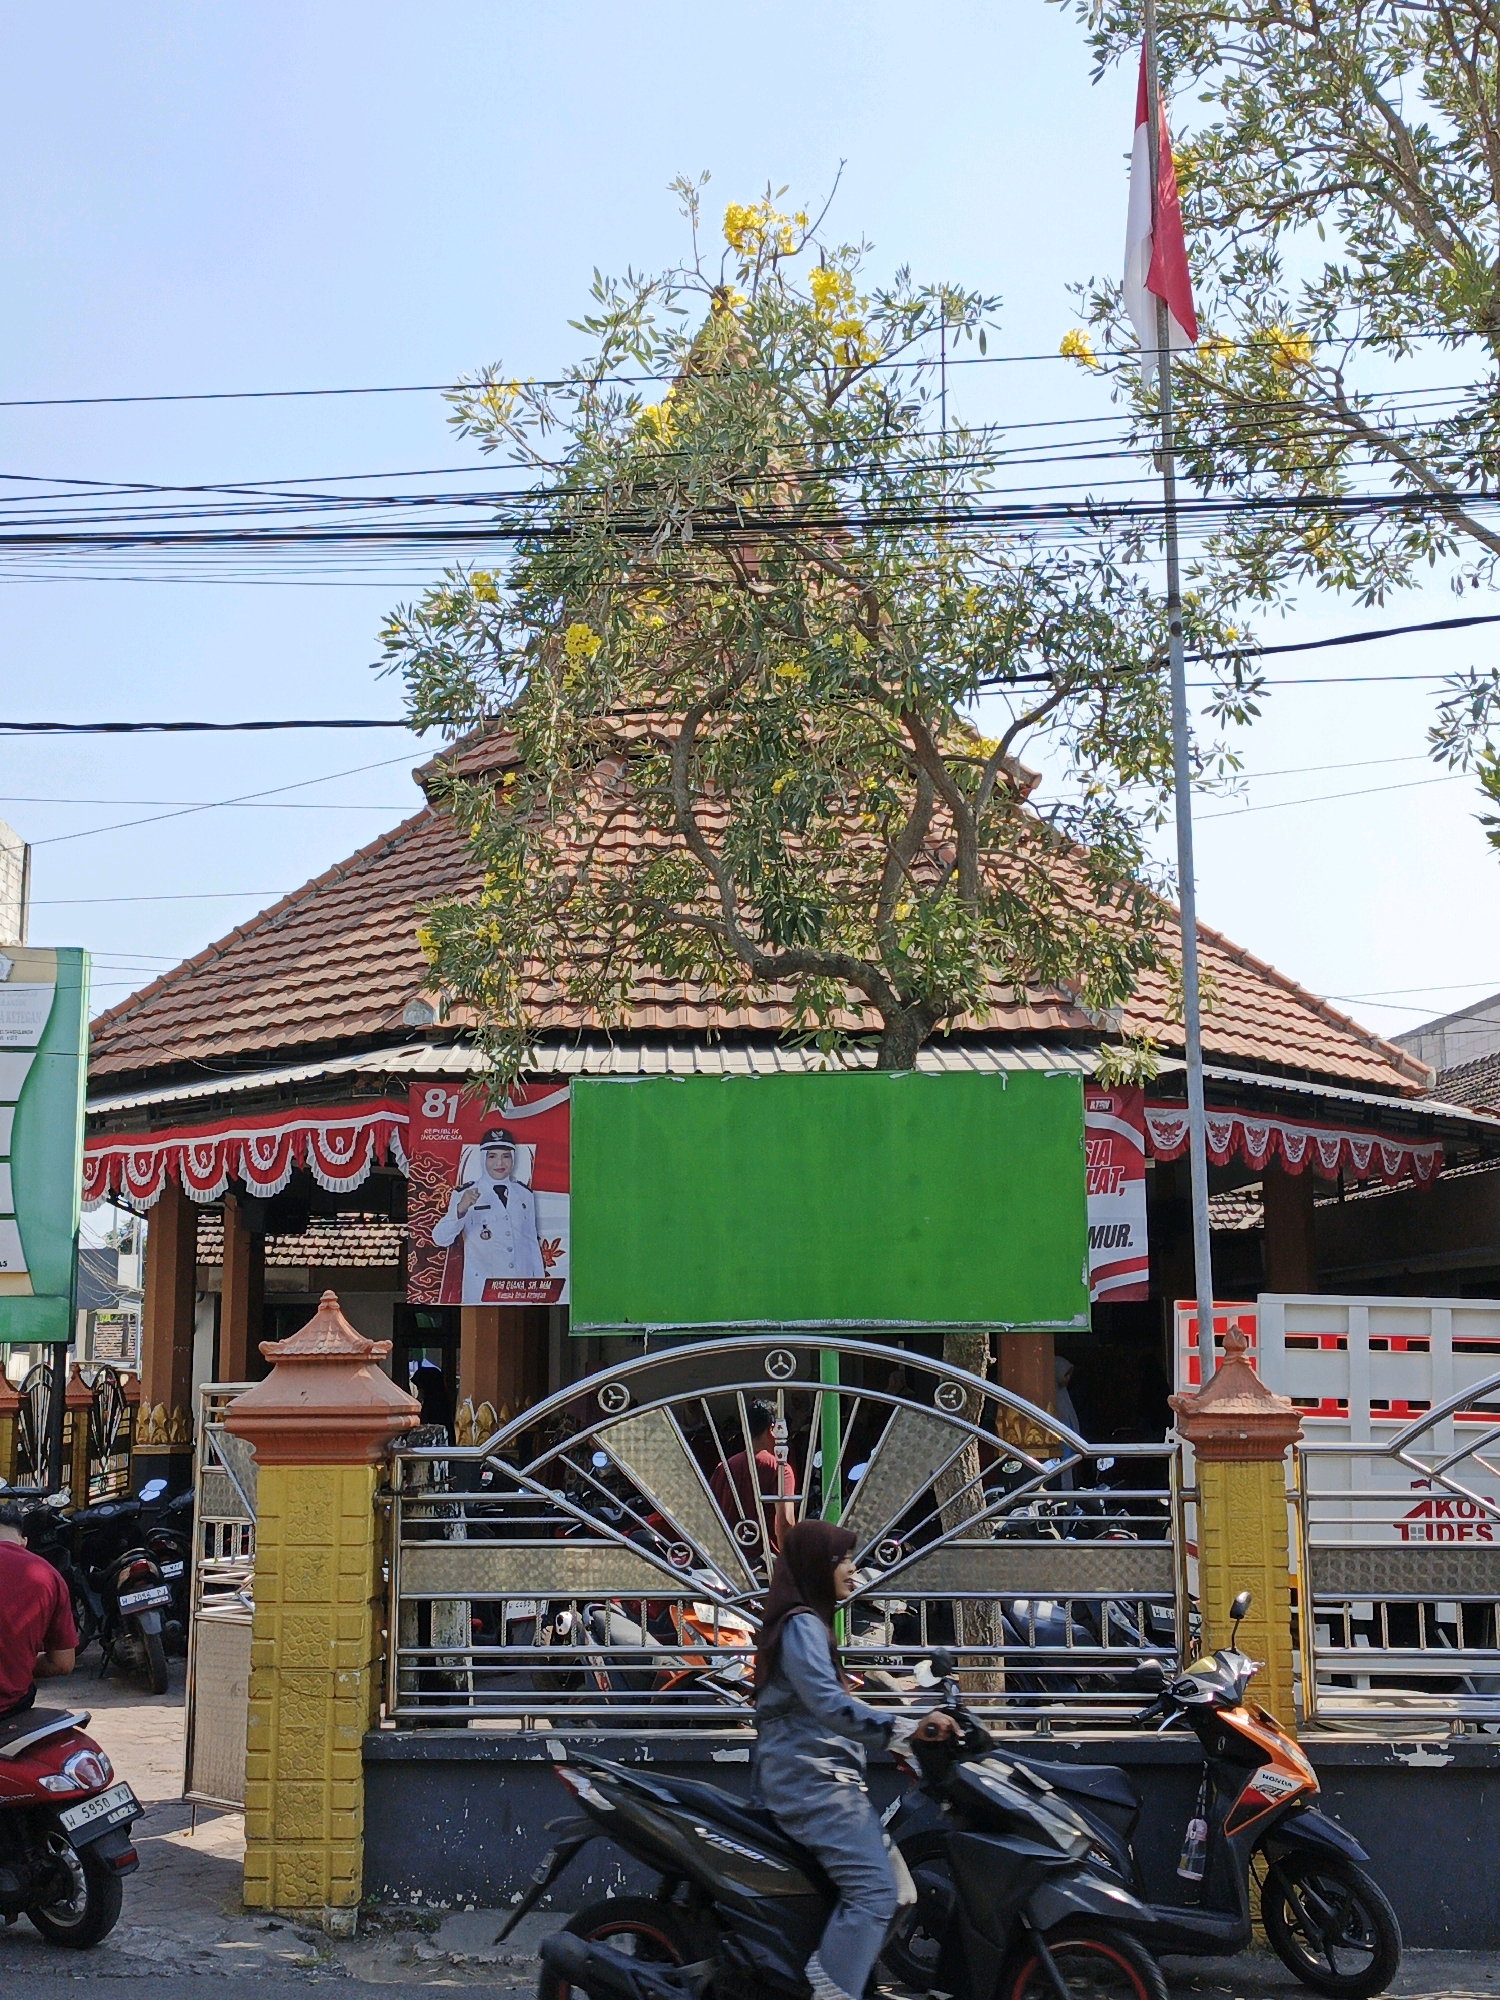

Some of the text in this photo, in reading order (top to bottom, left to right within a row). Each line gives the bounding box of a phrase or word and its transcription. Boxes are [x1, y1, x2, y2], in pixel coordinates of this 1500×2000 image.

[421, 1088, 459, 1124] 81
[1261, 1773, 1293, 1789] HONDA
[65, 1814, 77, 1828] W
[81, 1797, 111, 1819] 5950
